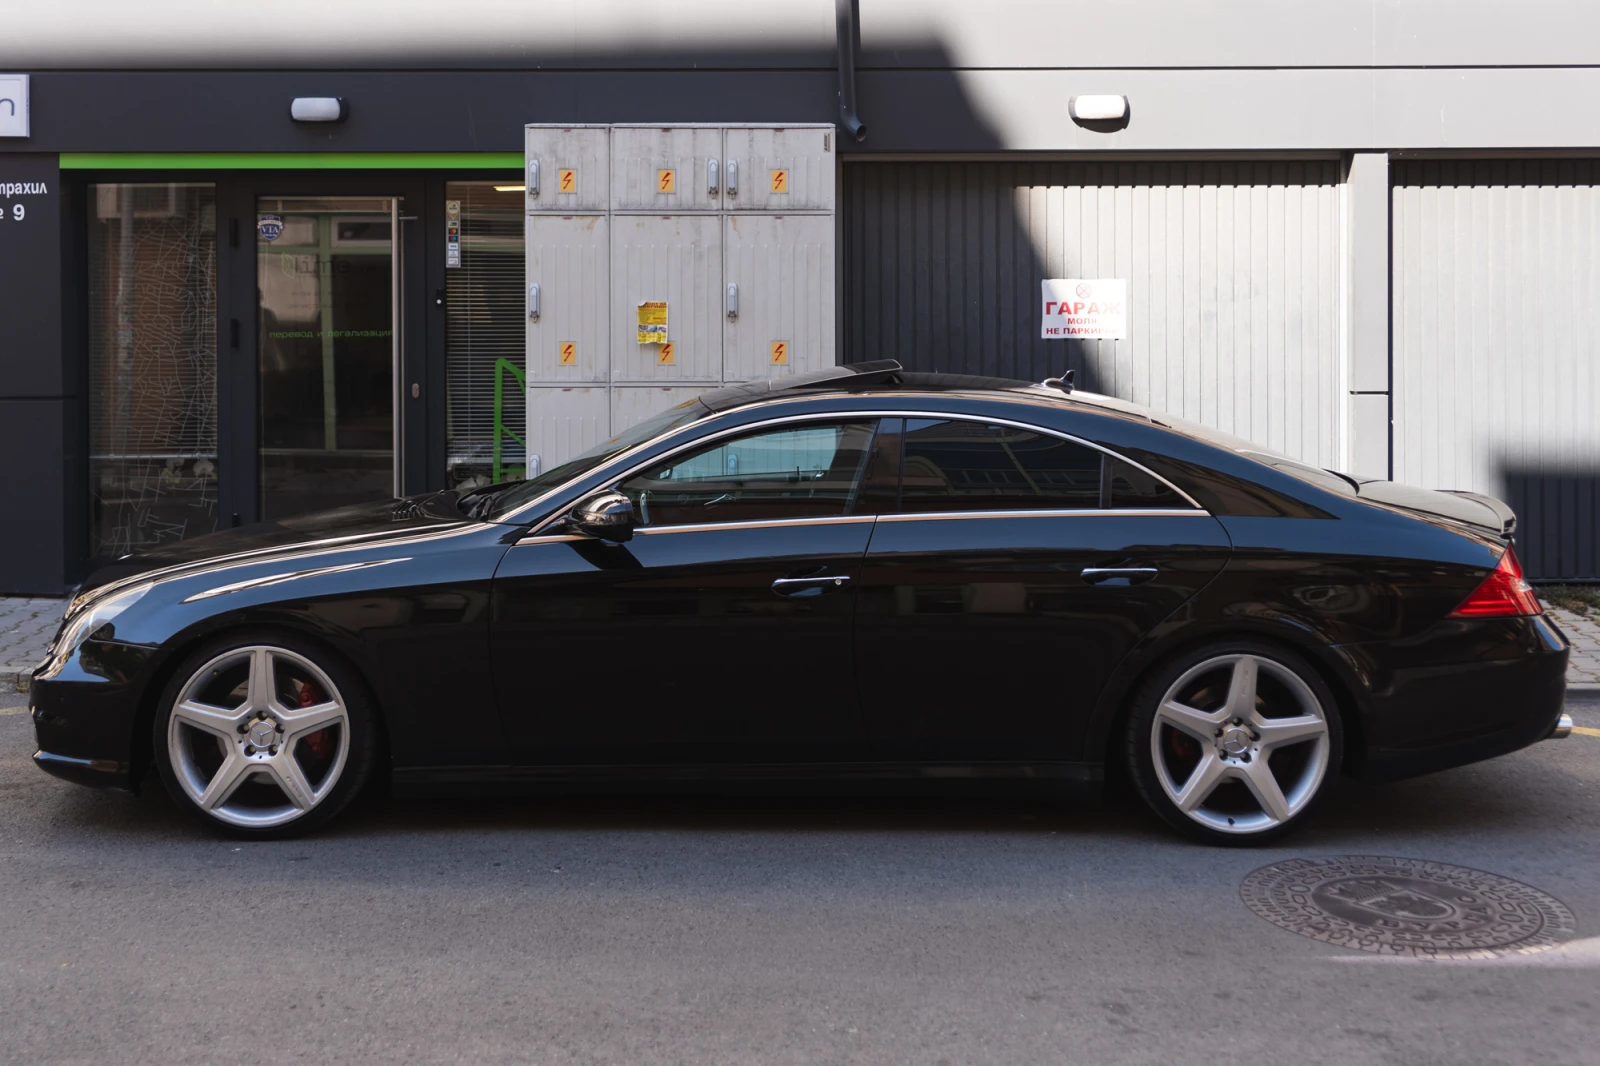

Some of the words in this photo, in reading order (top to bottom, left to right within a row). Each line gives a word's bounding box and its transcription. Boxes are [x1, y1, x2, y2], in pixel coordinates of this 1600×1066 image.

[13, 203, 25, 221] 9
[261, 225, 279, 234] VTA
[1046, 301, 1121, 315] ГАРАЖ
[269, 330, 314, 340] перевод
[1046, 327, 1060, 335] НЕ
